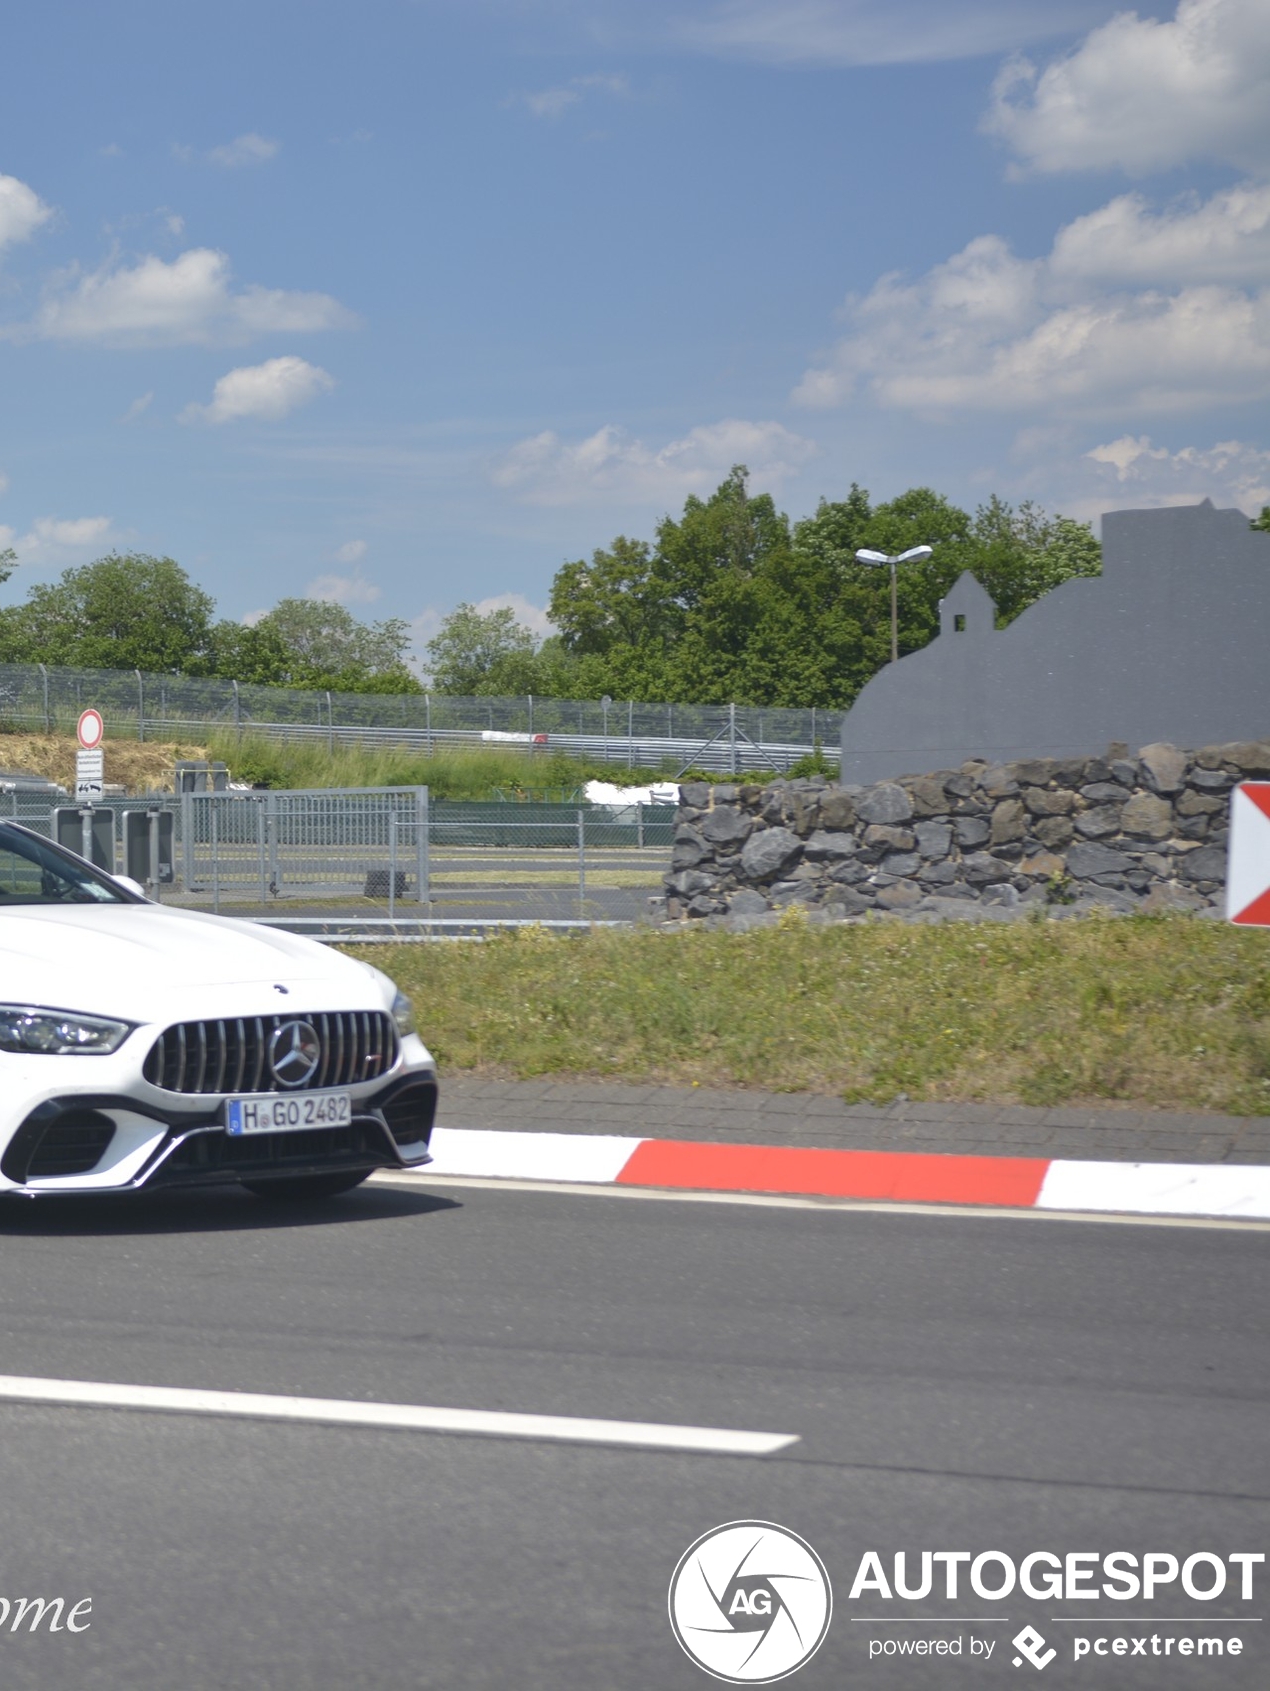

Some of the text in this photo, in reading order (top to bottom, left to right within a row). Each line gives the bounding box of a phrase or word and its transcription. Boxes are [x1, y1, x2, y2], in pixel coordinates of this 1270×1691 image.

[244, 1096, 348, 1129] H GO 2482
